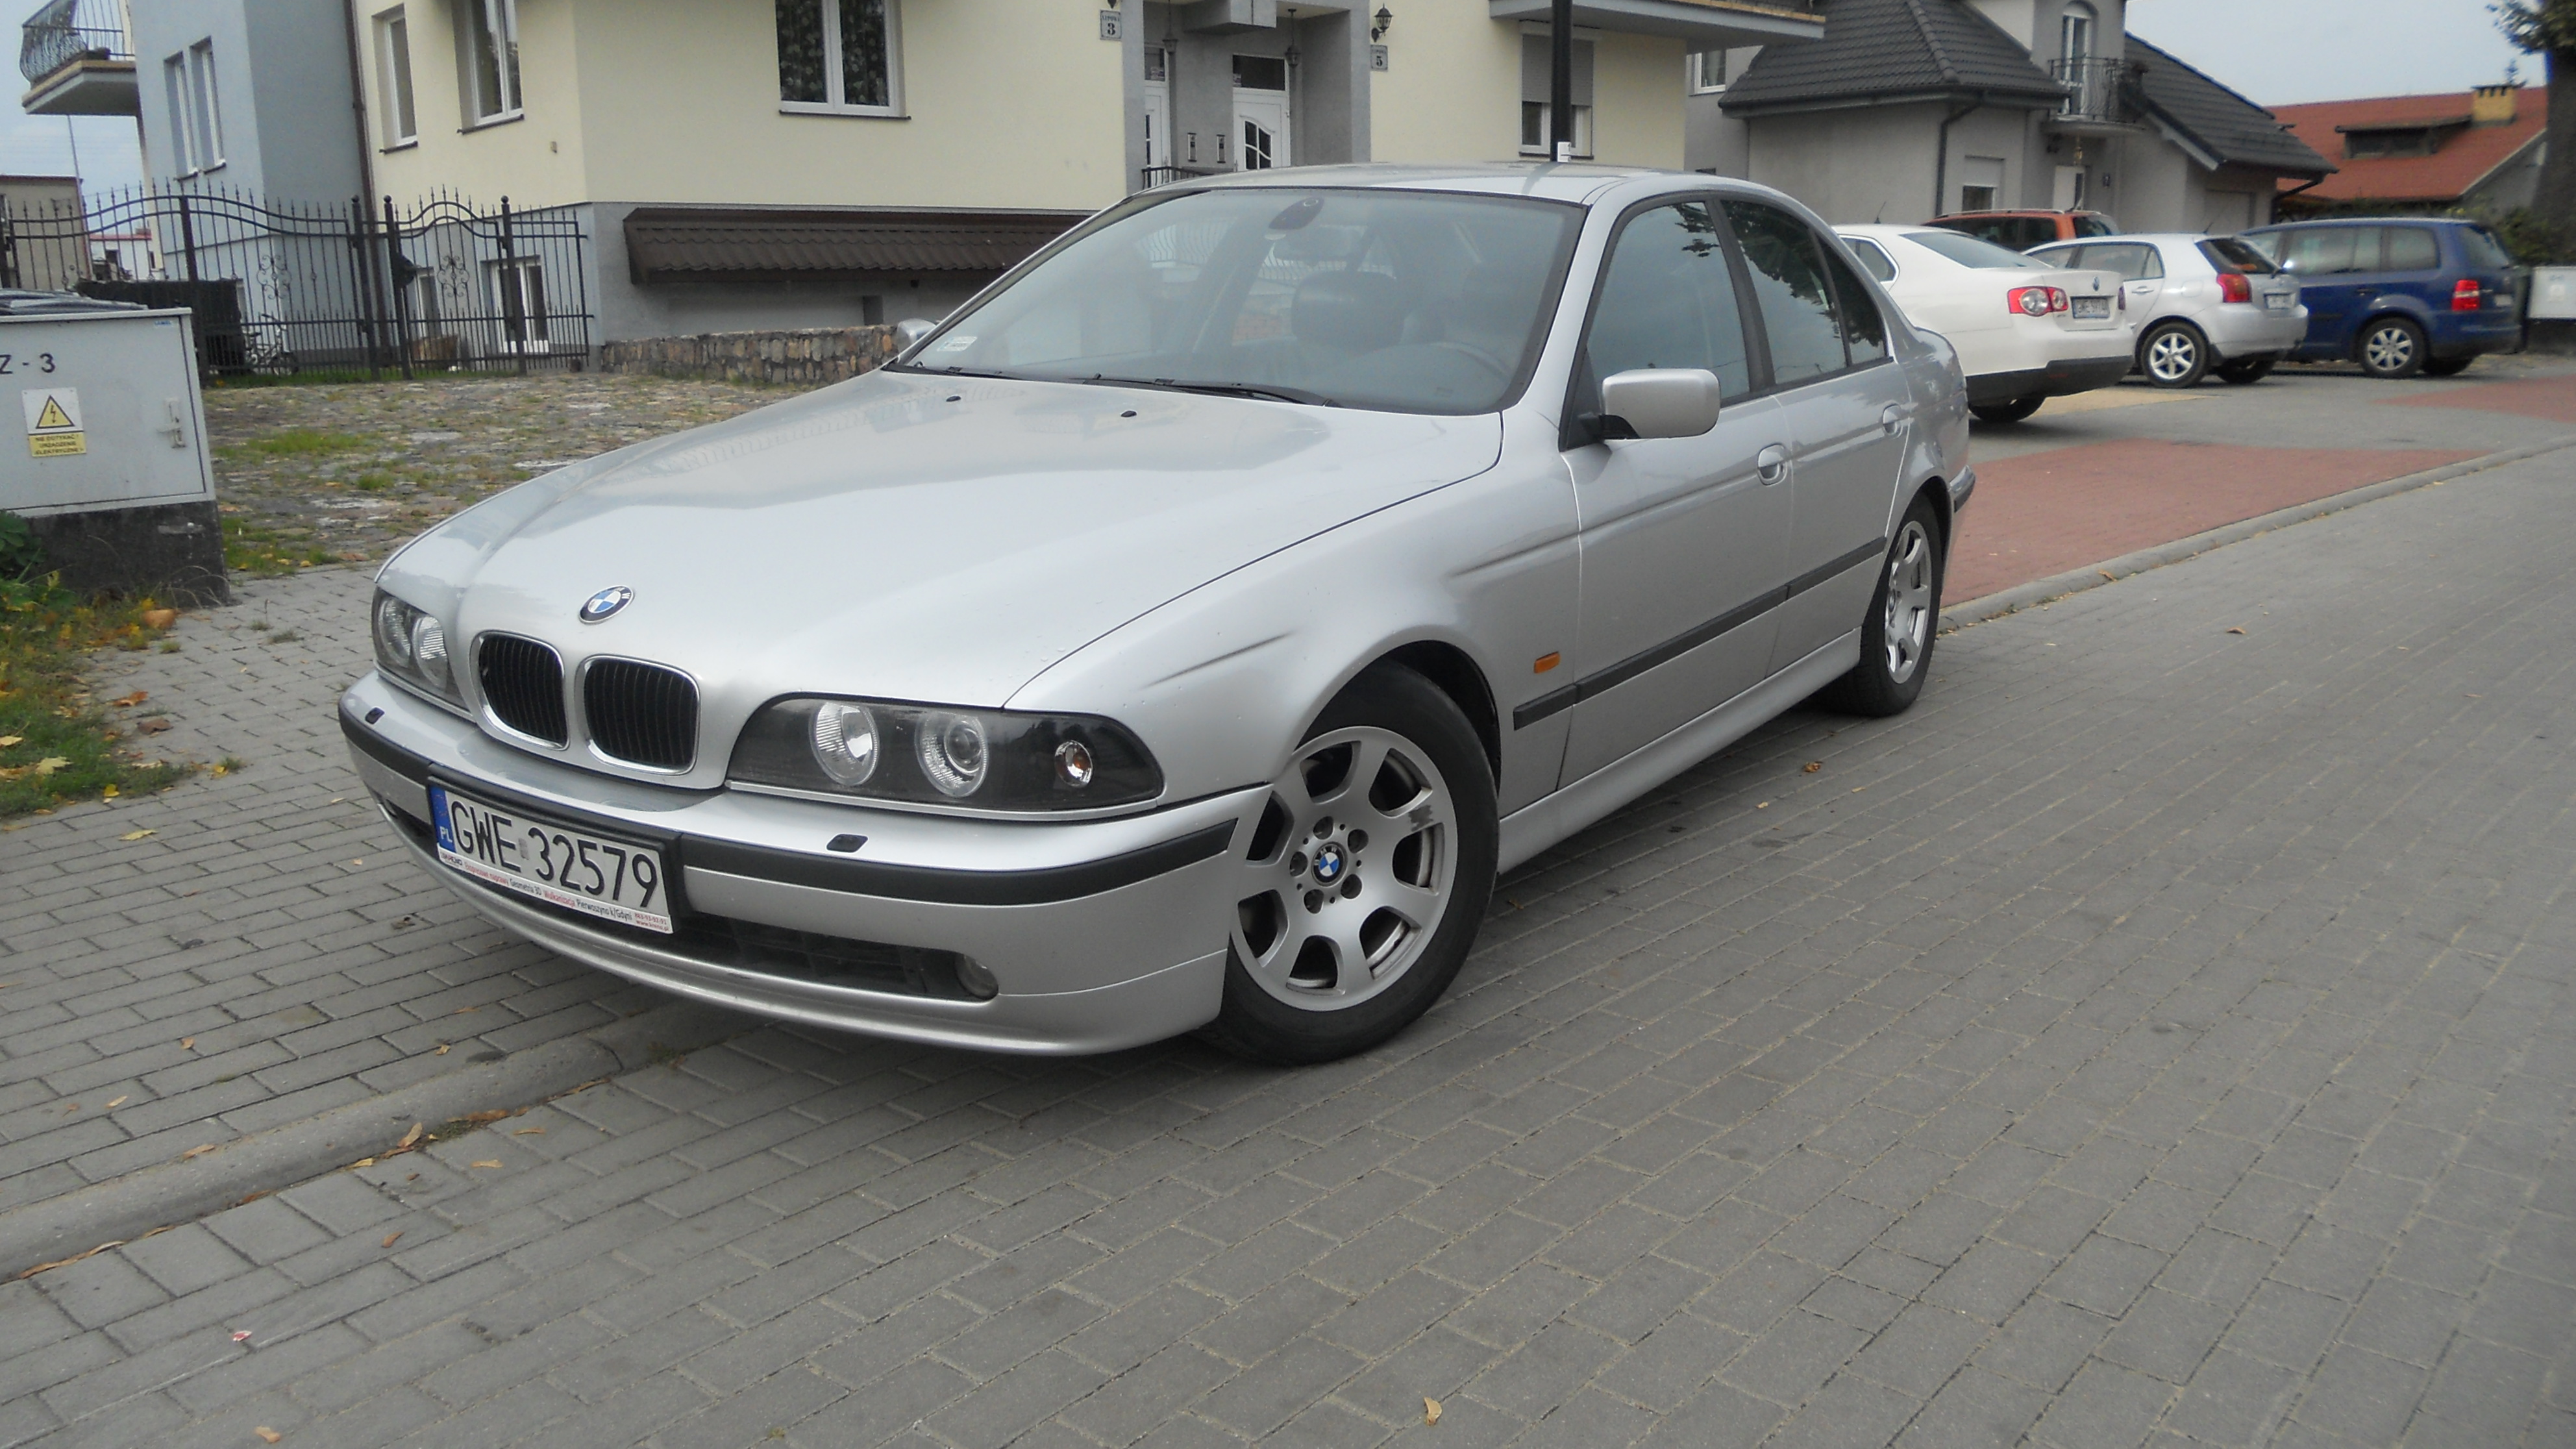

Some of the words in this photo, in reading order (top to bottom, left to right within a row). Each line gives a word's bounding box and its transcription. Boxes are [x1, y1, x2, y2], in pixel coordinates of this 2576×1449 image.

[1108, 23, 1116, 35] 3
[1376, 55, 1383, 67] 5
[40, 353, 56, 373] 3
[440, 825, 453, 843] PL
[451, 800, 521, 873] GWE
[528, 827, 658, 908] 32579
